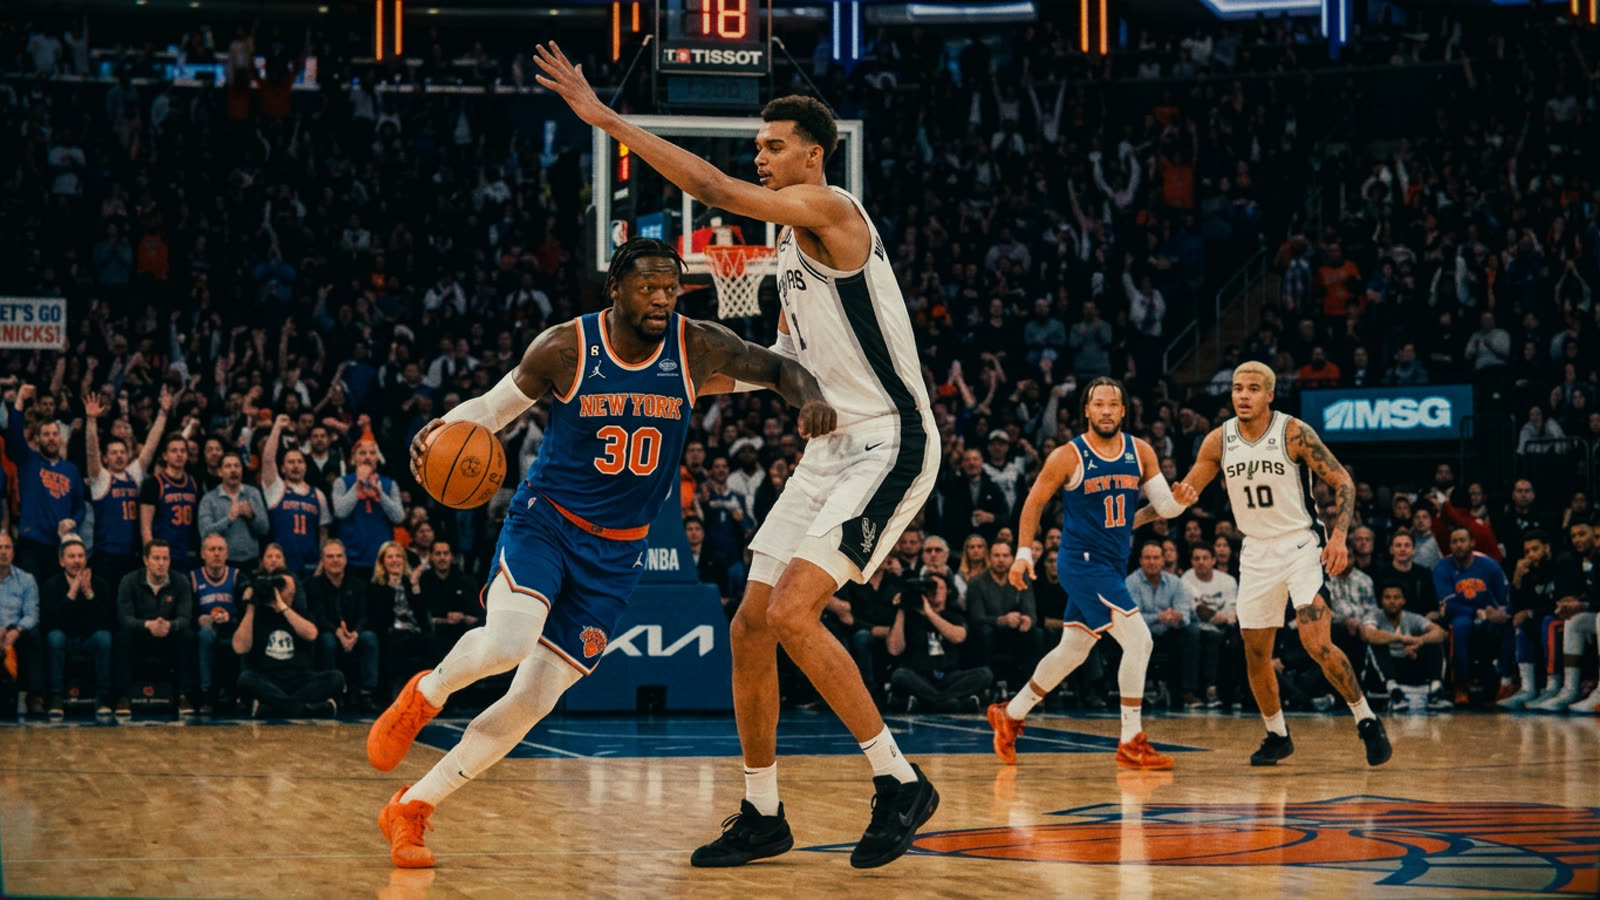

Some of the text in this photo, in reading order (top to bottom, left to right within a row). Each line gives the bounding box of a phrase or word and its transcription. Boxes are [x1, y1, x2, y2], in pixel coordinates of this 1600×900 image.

[702, 0, 747, 38] 18
[691, 49, 762, 65] TISSOT
[0, 303, 62, 322] ET'S GO
[0, 324, 61, 344] NICKS!
[579, 393, 683, 420] NEW YORK
[1354, 397, 1452, 430] MSG
[594, 425, 662, 476] 30
[1226, 460, 1285, 480] SPURS
[1244, 485, 1274, 509] 10
[171, 505, 192, 526] 30
[1103, 494, 1126, 528] 11
[293, 514, 307, 535] 11
[648, 547, 680, 571] NBA
